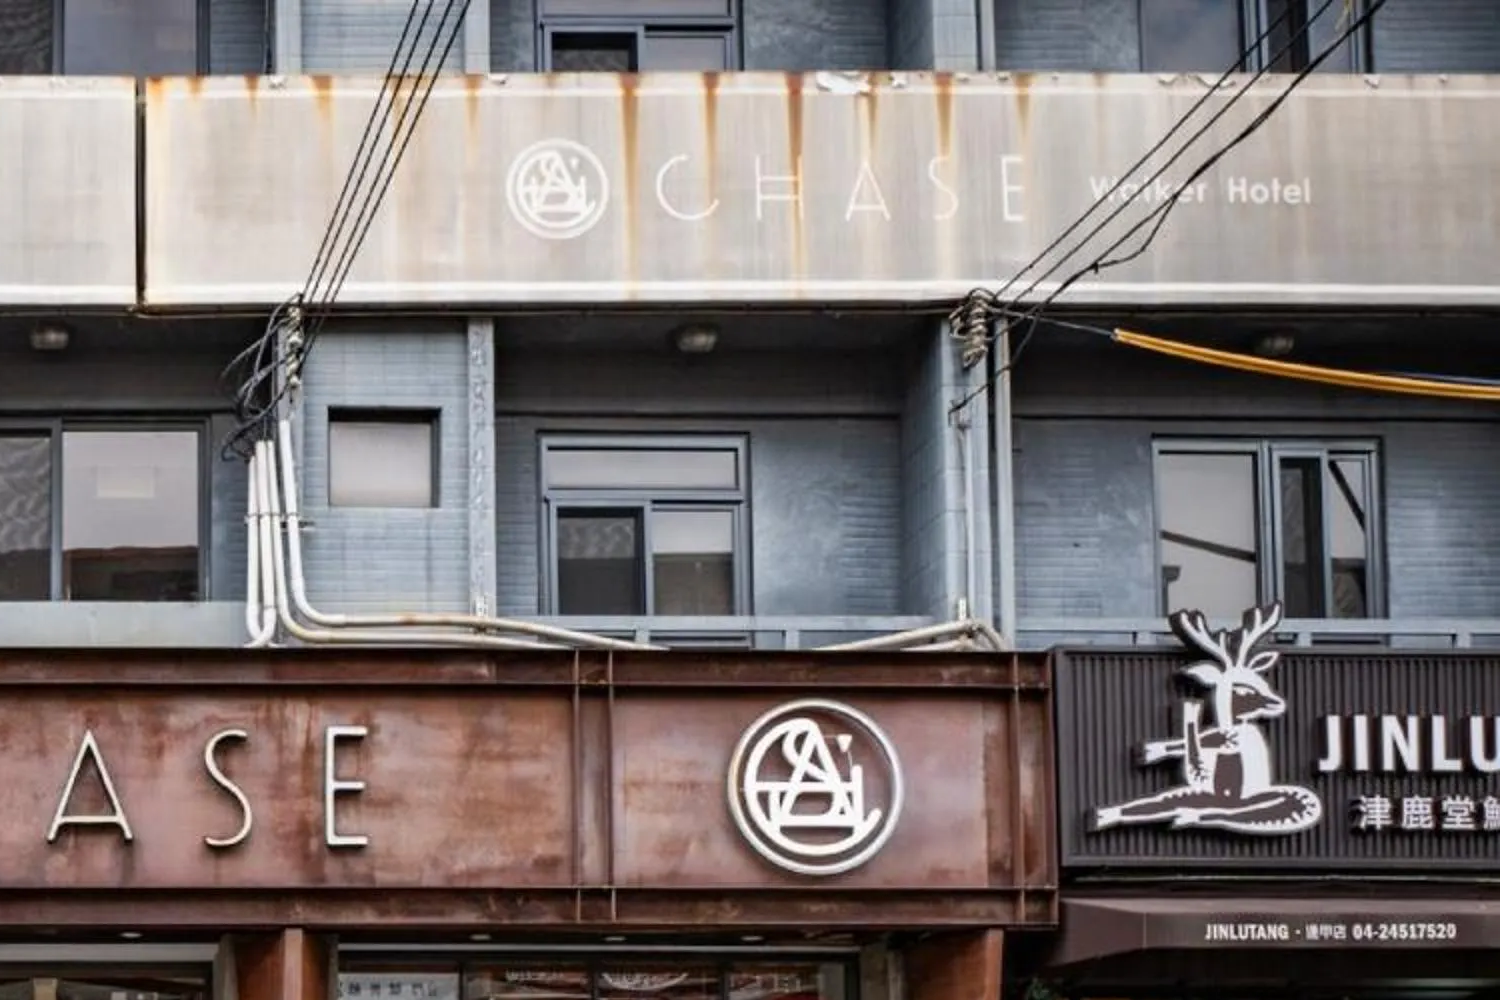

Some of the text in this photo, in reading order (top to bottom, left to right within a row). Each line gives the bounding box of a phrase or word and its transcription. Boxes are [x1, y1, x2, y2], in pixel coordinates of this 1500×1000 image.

[656, 154, 1311, 221] CHASE Walker Hotel
[1204, 923, 1289, 941] JINLUTANG
[1352, 922, 1457, 940] 04-24517520
